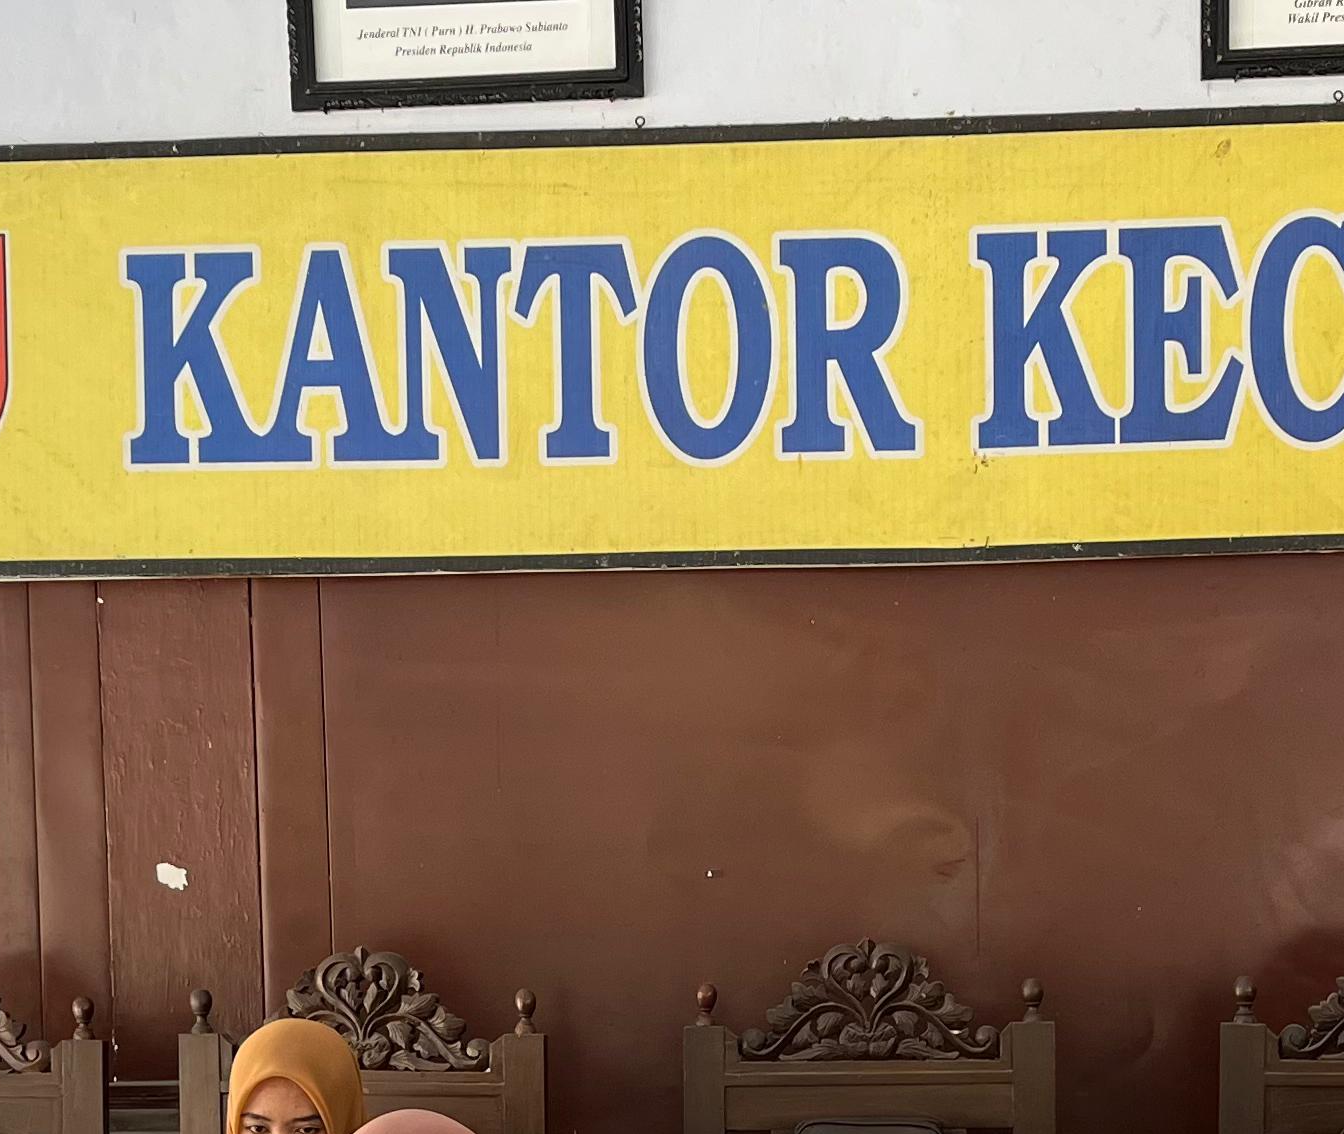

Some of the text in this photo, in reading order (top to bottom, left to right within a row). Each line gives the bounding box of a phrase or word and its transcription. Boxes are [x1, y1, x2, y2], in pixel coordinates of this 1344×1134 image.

[1288, 12, 1320, 24] Wakil
[356, 27, 400, 40] Jenderal
[402, 26, 422, 38] TNI
[479, 22, 523, 35] Prabowo
[525, 20, 568, 33] Subianto
[395, 41, 532, 57] Presiden Republik Indonesia
[126, 234, 918, 465] KANTOR
